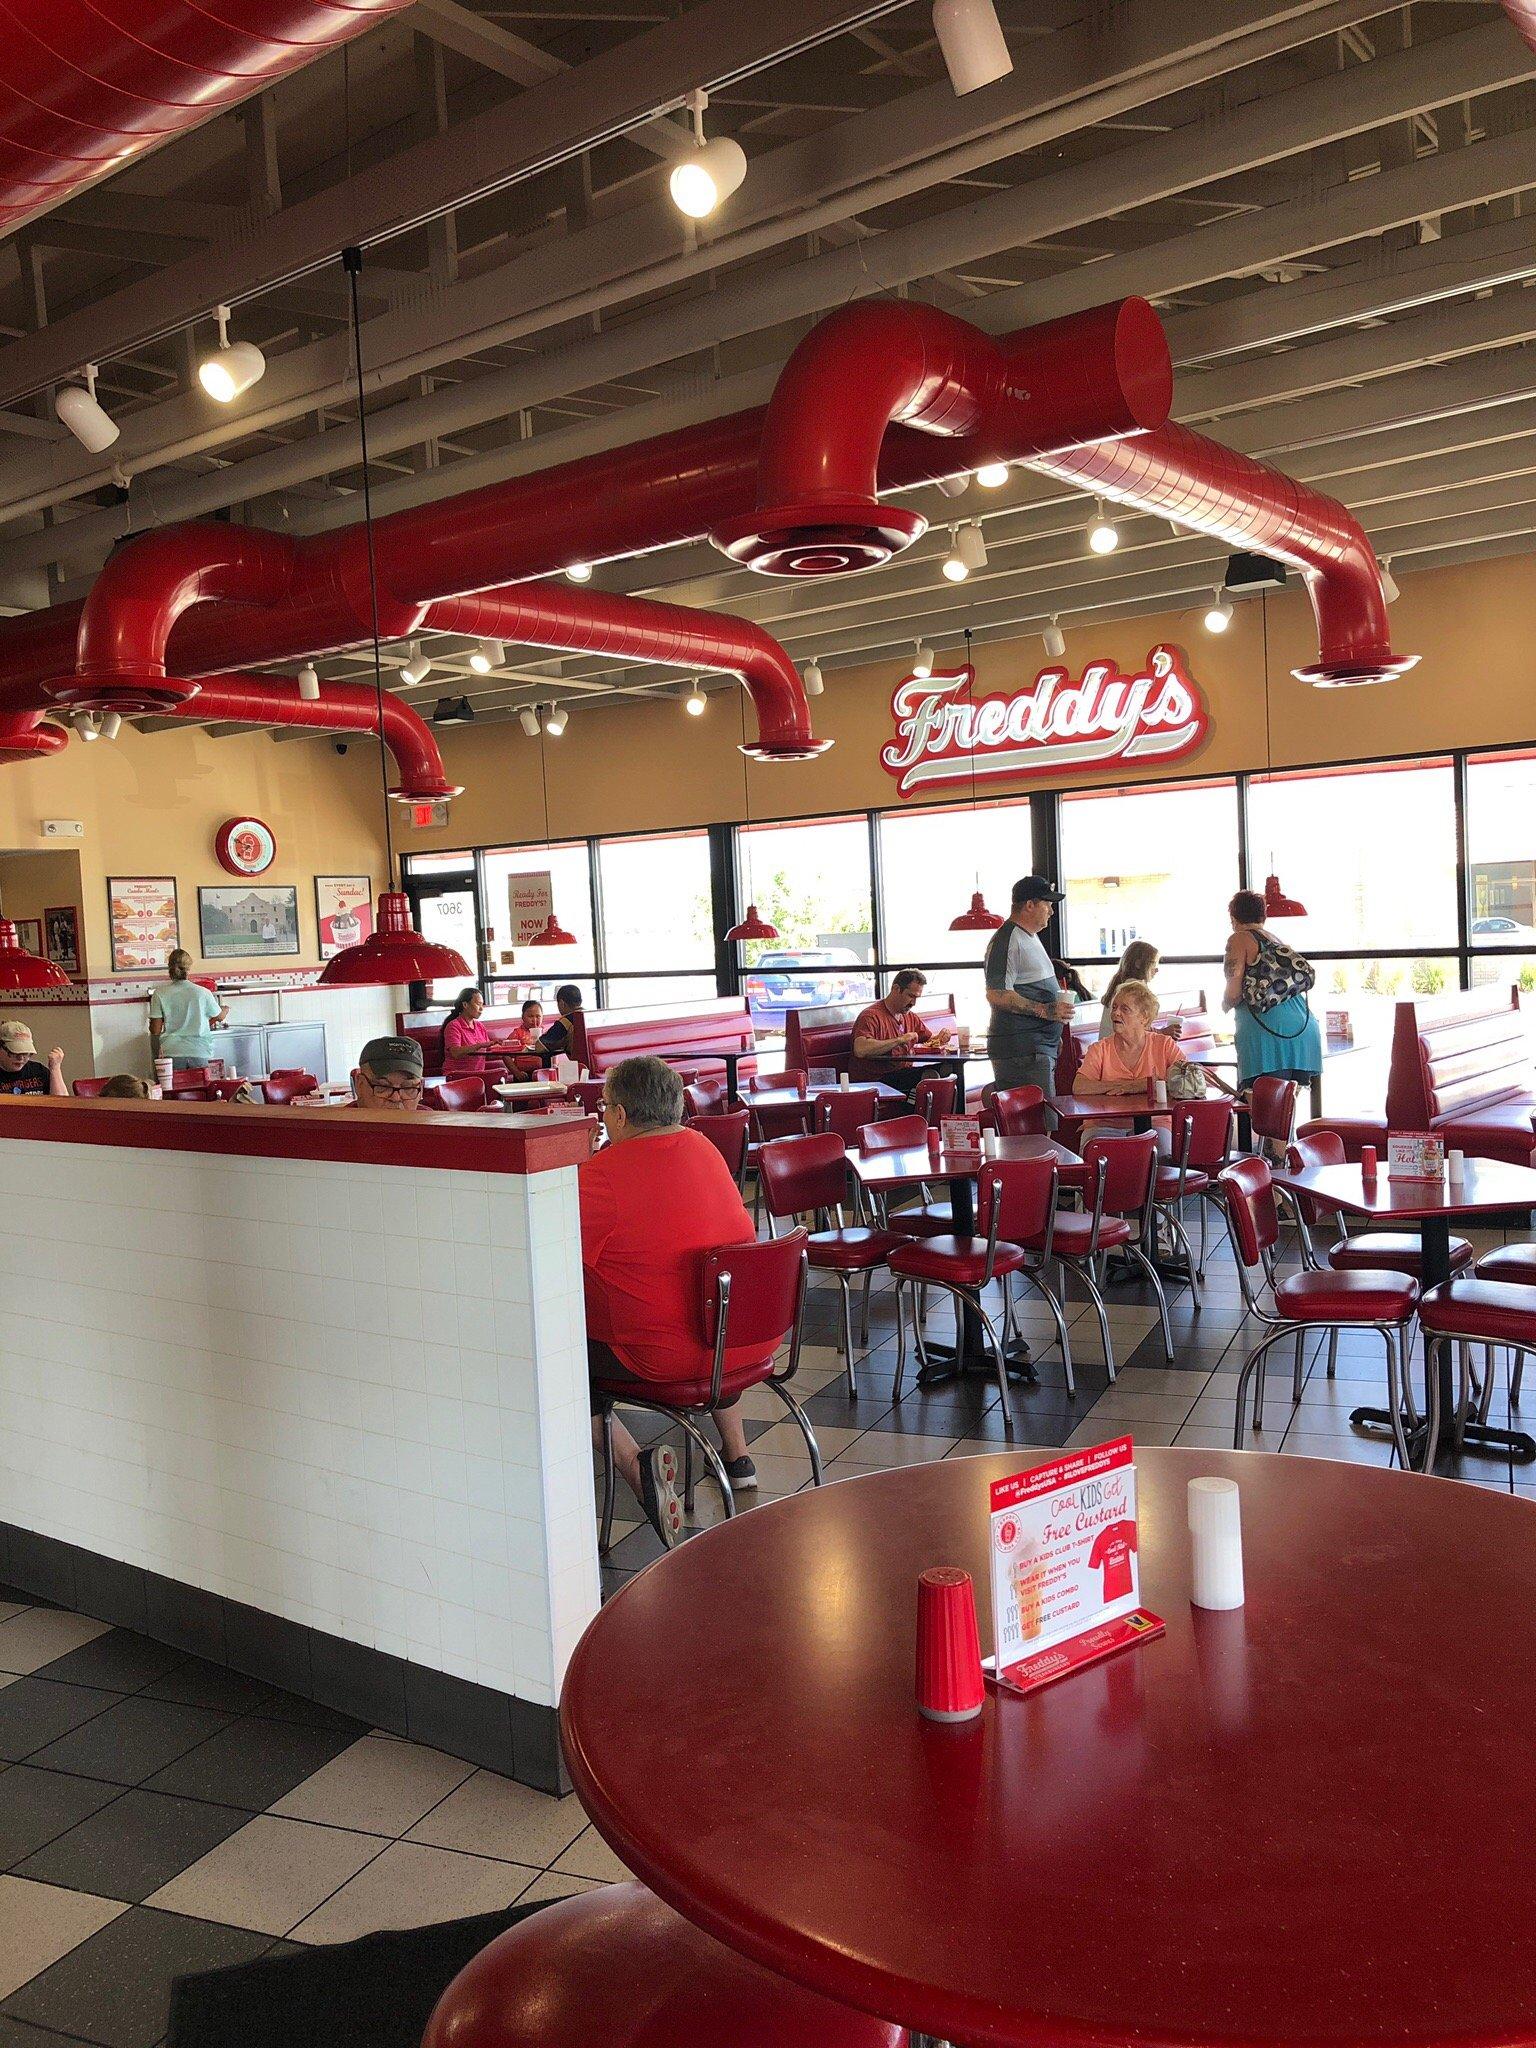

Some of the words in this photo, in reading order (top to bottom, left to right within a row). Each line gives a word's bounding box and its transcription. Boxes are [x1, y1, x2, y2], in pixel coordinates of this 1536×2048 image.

[883, 647, 1199, 788] Freddy's
[512, 889, 535, 899] Ready
[536, 889, 548, 897] For
[520, 919, 544, 929] NOW
[1394, 1153, 1416, 1163] Hot
[995, 1485, 1010, 1495] LIKE
[1010, 1481, 1020, 1490] US
[1029, 1469, 1059, 1483] CAPTURE
[1063, 1459, 1085, 1472] SHARE
[1094, 1449, 1119, 1461] FOLLOW
[1119, 1444, 1128, 1453] US
[1051, 1493, 1080, 1518] Cool
[1080, 1481, 1102, 1511] KIDS
[1042, 1523, 1071, 1545] Free
[1075, 1496, 1127, 1531] Custard
[1019, 1558, 1033, 1570] BUY
[1033, 1556, 1039, 1564] A
[1040, 1550, 1054, 1561] KIDS
[1055, 1544, 1071, 1555] CLUB
[1072, 1534, 1095, 1549] T-SHIRT
[1020, 1573, 1040, 1586] WEAR
[1040, 1570, 1047, 1579] IT
[1047, 1563, 1067, 1575] WHEN
[1067, 1557, 1081, 1567] YOU
[1020, 1585, 1037, 1596] VISIT
[1037, 1572, 1067, 1589] FREDDY'S
[1021, 1603, 1035, 1614] BUY
[1041, 1594, 1056, 1605] KIDS
[1057, 1584, 1079, 1599] COMBO
[1021, 1619, 1036, 1630] GET
[1036, 1613, 1051, 1625] FREE
[1052, 1601, 1080, 1618] CUSTARD
[1016, 1651, 1070, 1678] Freddy's
